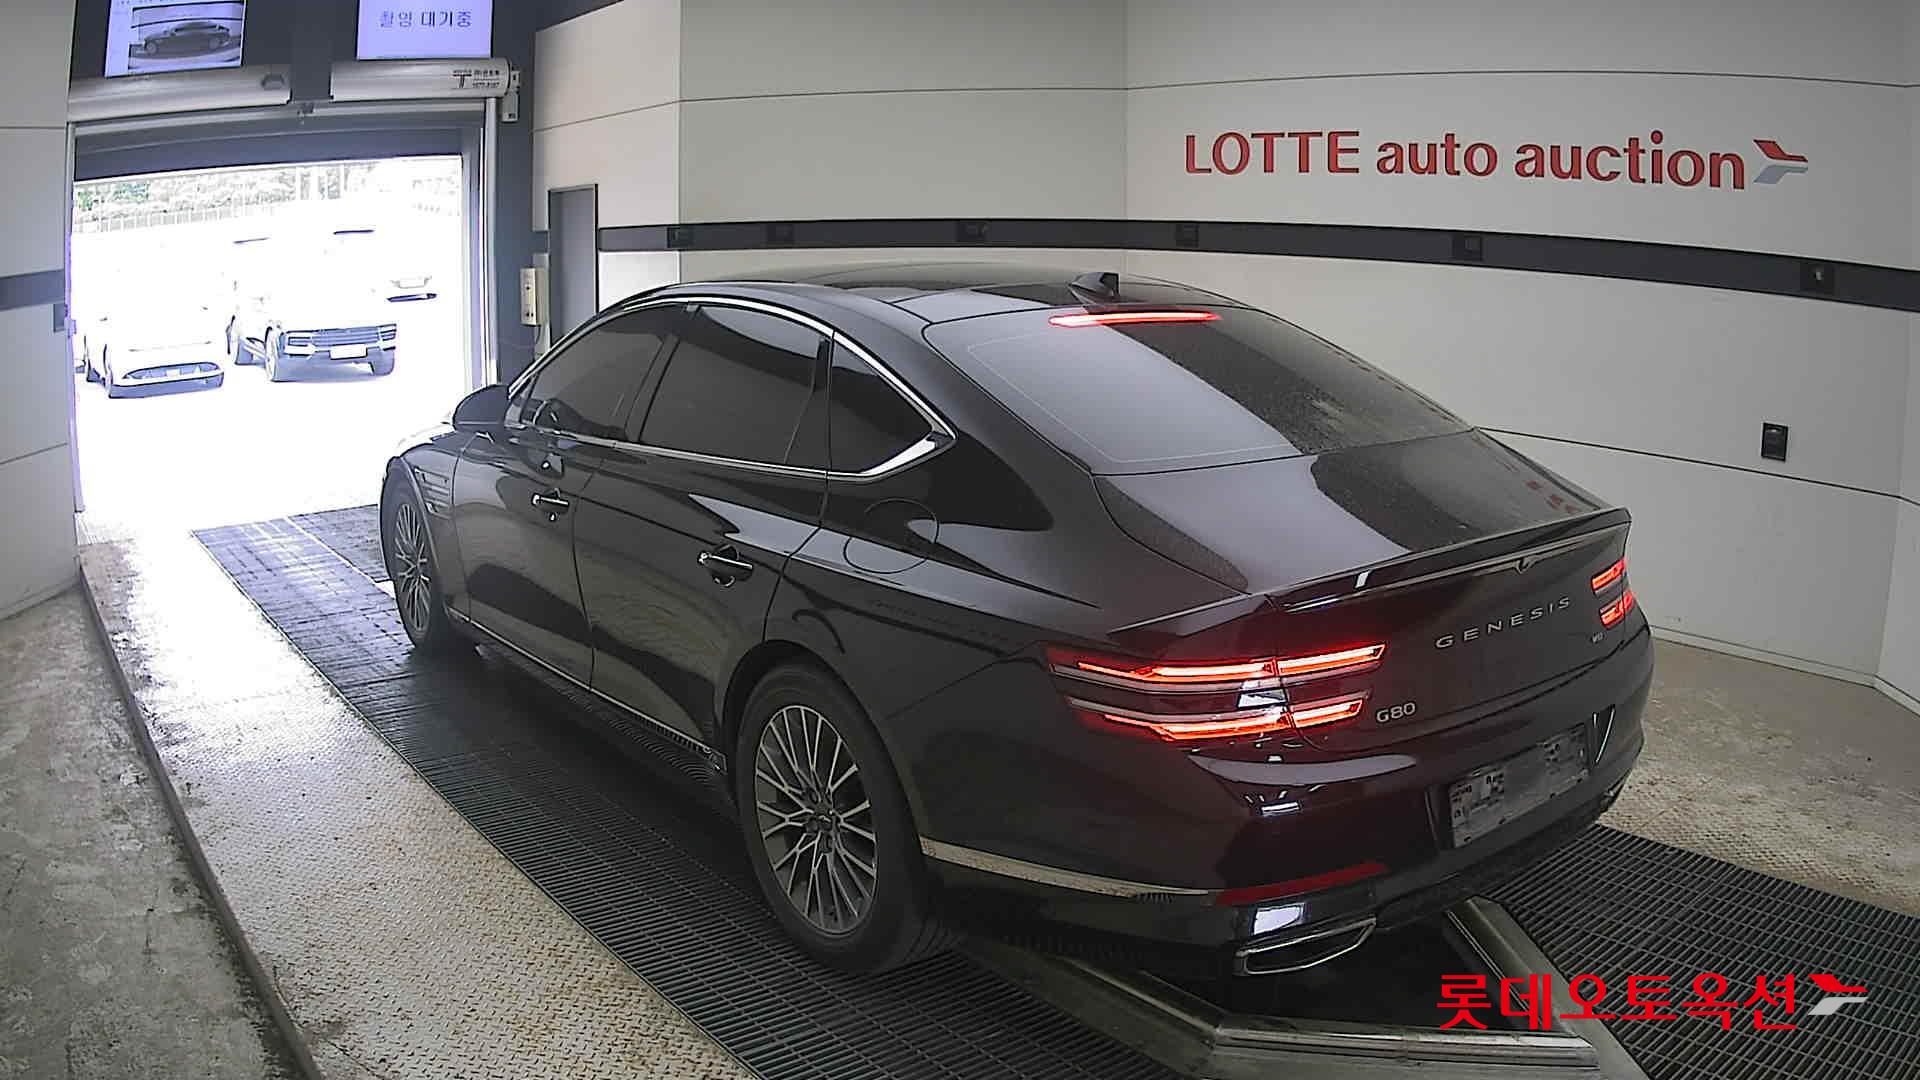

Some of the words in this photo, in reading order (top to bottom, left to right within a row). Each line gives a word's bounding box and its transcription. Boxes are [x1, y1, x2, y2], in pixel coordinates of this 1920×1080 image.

[420, 10, 473, 28] 대기중
[1185, 130, 1360, 175] LOTTE
[1377, 133, 1498, 177] auto
[1514, 131, 1745, 190] auction
[1435, 596, 1571, 649] GENESIS
[1375, 702, 1417, 723] G80
